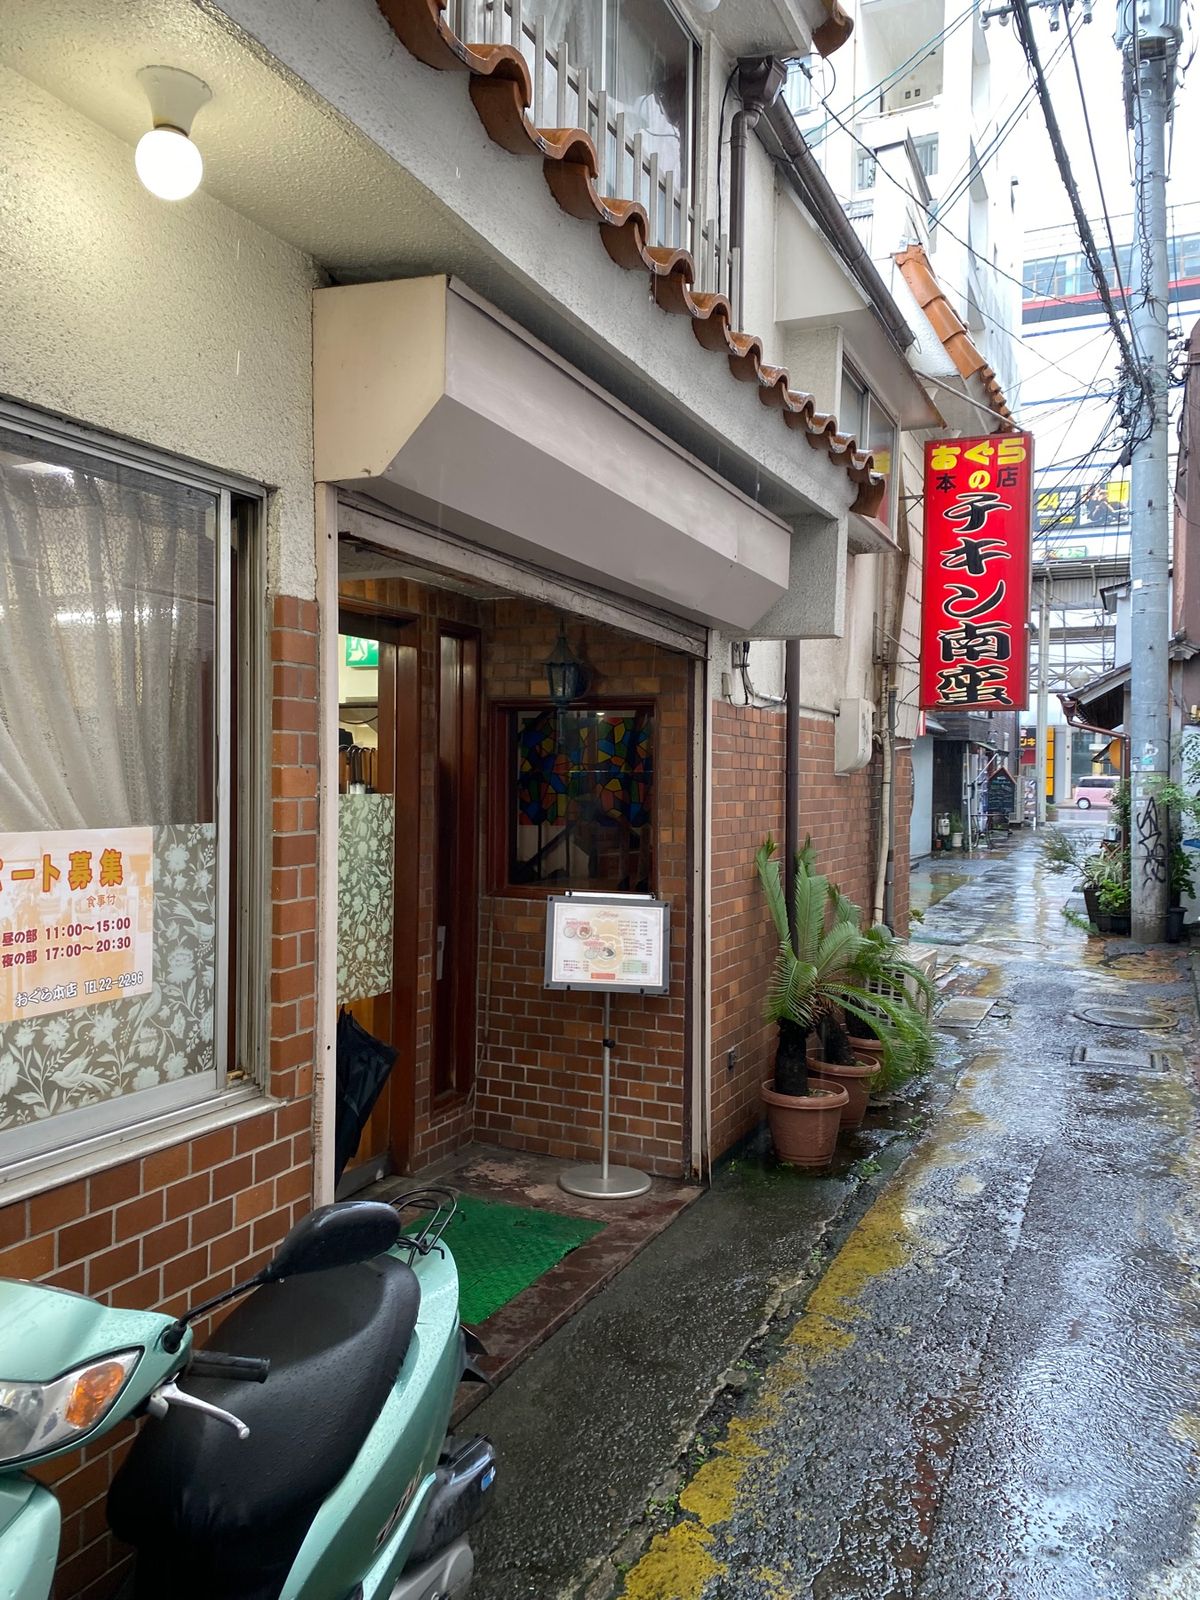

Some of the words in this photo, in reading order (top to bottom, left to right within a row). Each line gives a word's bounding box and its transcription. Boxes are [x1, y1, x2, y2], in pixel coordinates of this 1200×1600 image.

[930, 437, 1027, 471] おぐら
[936, 492, 1014, 706] チキン南蛮
[0, 848, 124, 893] ート募集
[86, 894, 117, 908] 食事付
[2, 928, 38, 947] 昼の部
[2, 949, 38, 968] 夜の部
[16, 982, 79, 1007] おぐら本店
